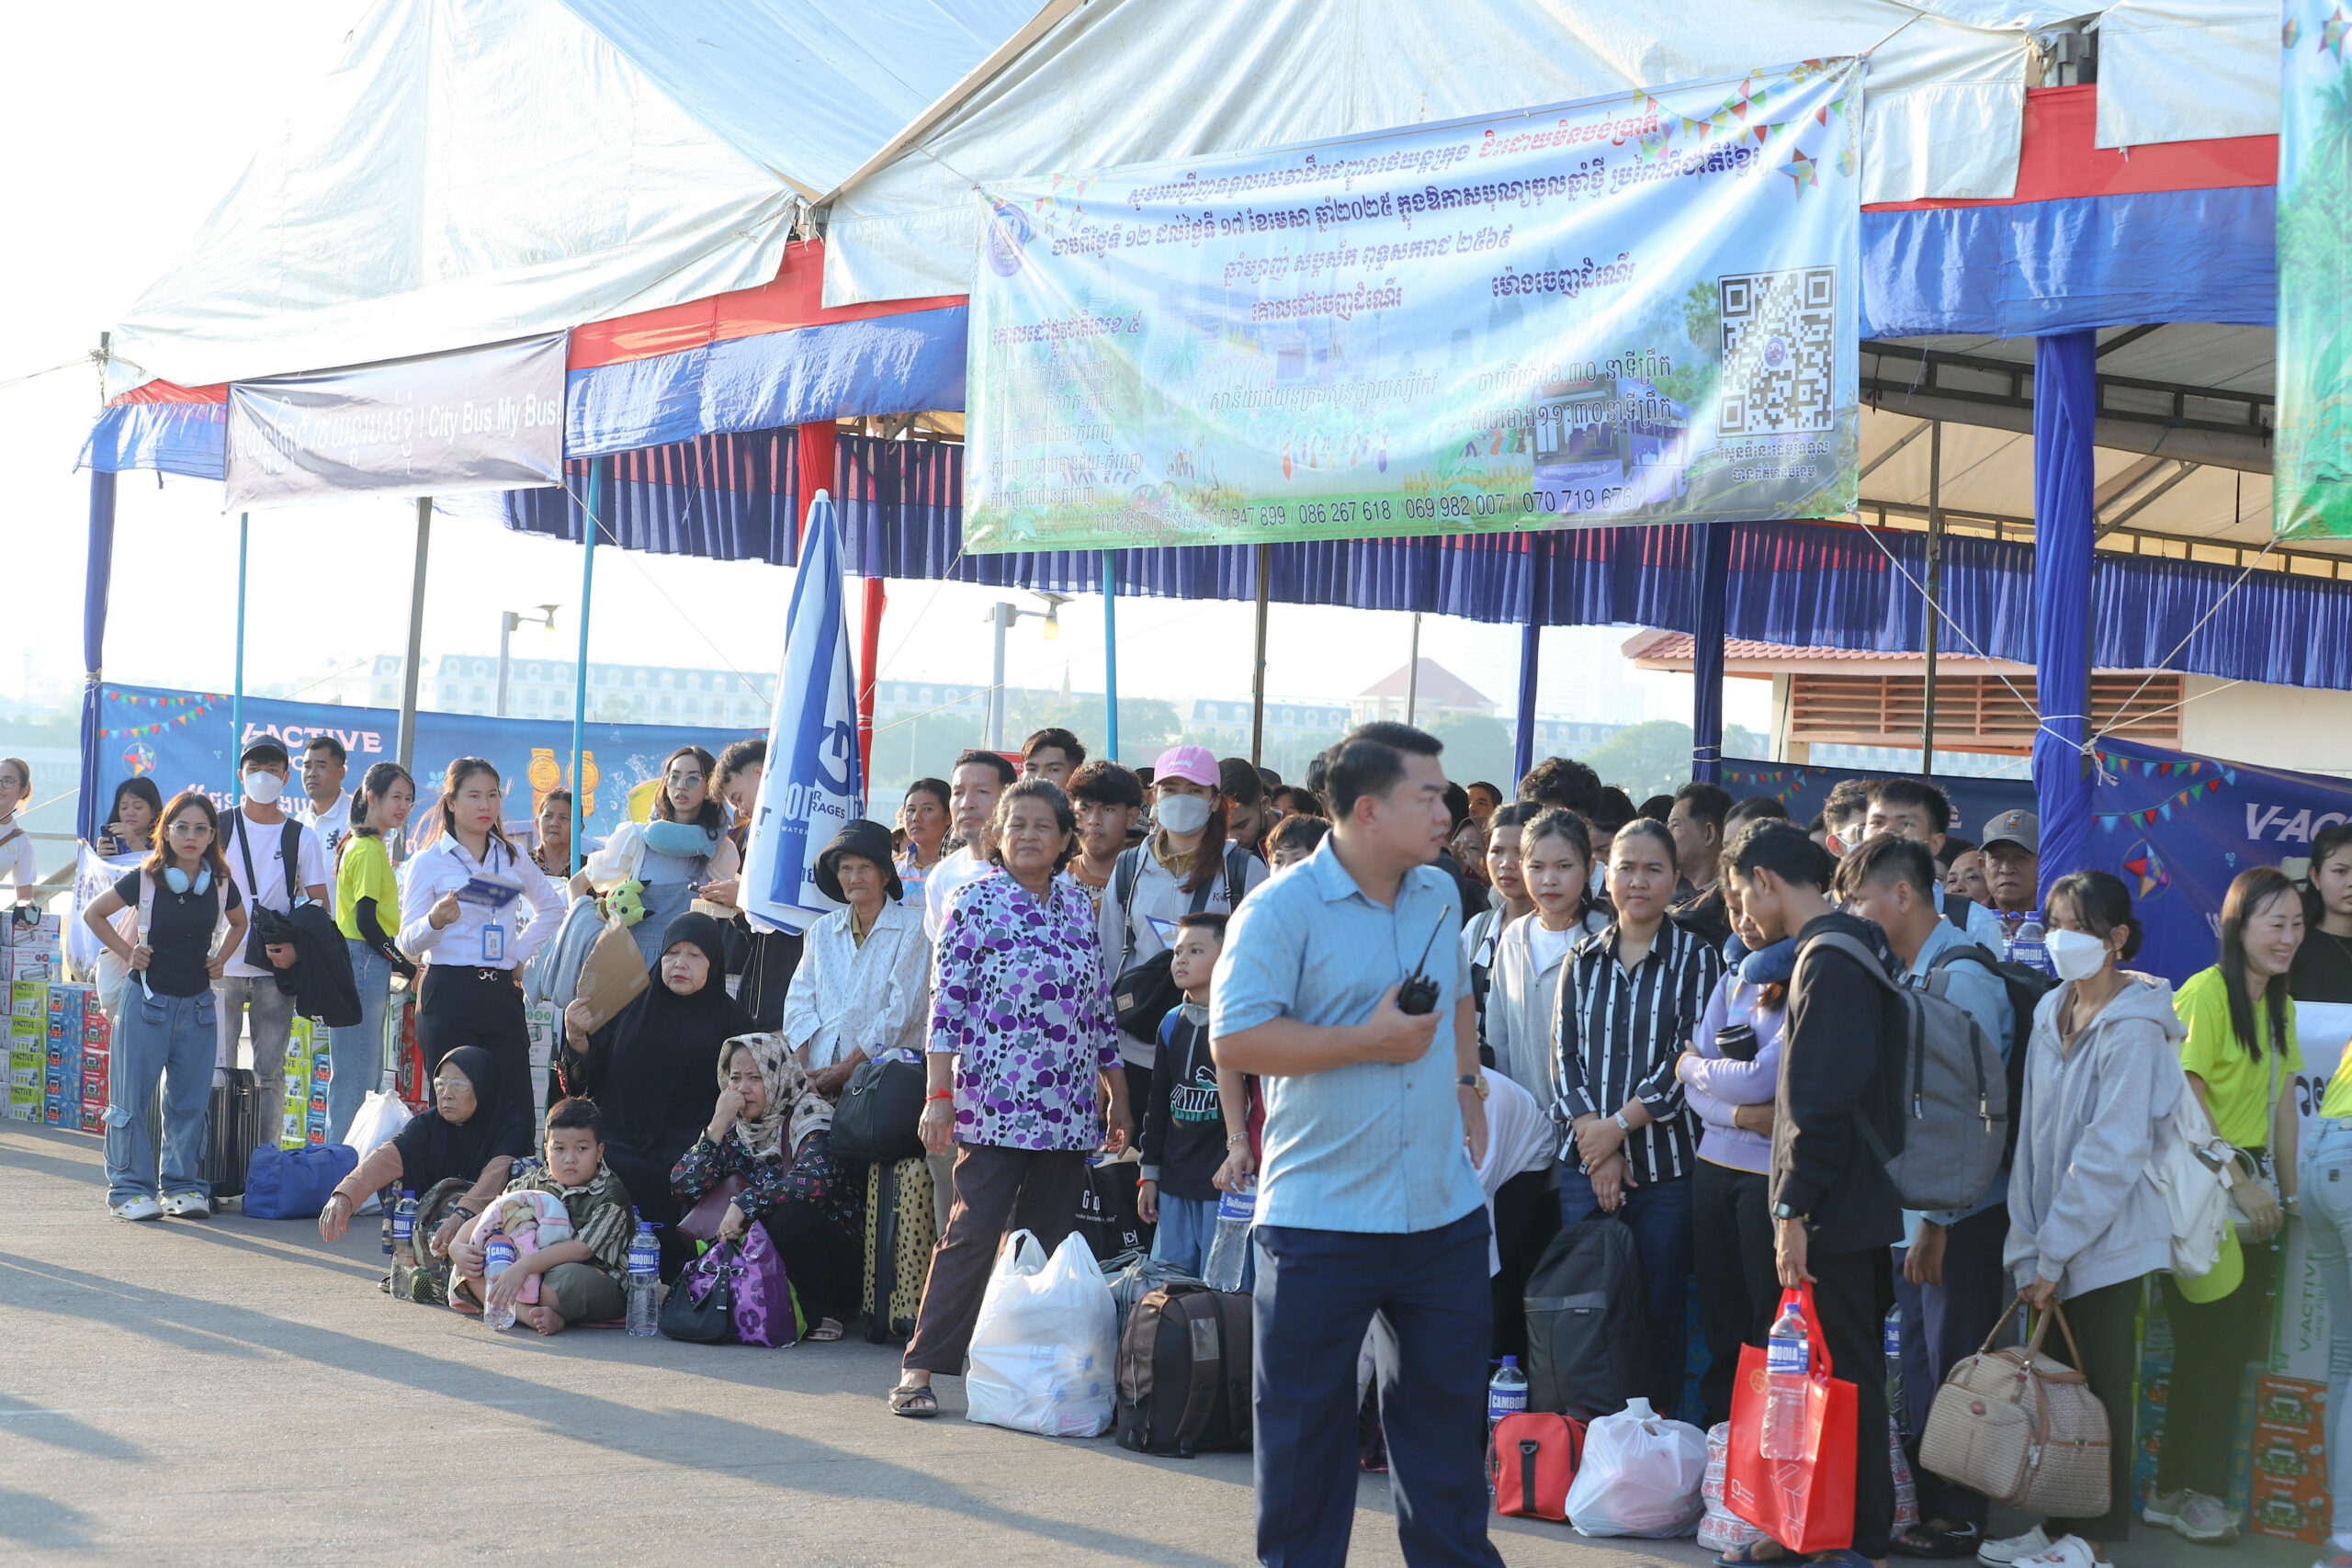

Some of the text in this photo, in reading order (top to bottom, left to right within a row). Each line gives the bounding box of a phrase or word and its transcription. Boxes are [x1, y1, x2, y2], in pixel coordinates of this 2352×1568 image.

[1125, 230, 1151, 249] ១២
[1219, 214, 1244, 239] ១៧
[1249, 204, 1311, 232] ខែមេសា
[428, 411, 461, 445] City
[462, 401, 492, 434] Bus
[497, 397, 522, 437] My
[1203, 508, 1227, 529] 010
[1231, 506, 1255, 527] 947
[1260, 505, 1286, 526] 899
[1298, 502, 1327, 525] 086
[1331, 502, 1357, 524] 267
[1363, 499, 1392, 521] 618
[1406, 497, 1435, 519] 069
[1440, 496, 1470, 517] 982
[1476, 493, 1506, 515] 007
[1522, 491, 1555, 513] 070
[1561, 489, 1594, 511] 719
[1600, 487, 1633, 510] 676
[781, 825, 808, 836] WATER
[2245, 802, 2352, 844] V-AC
